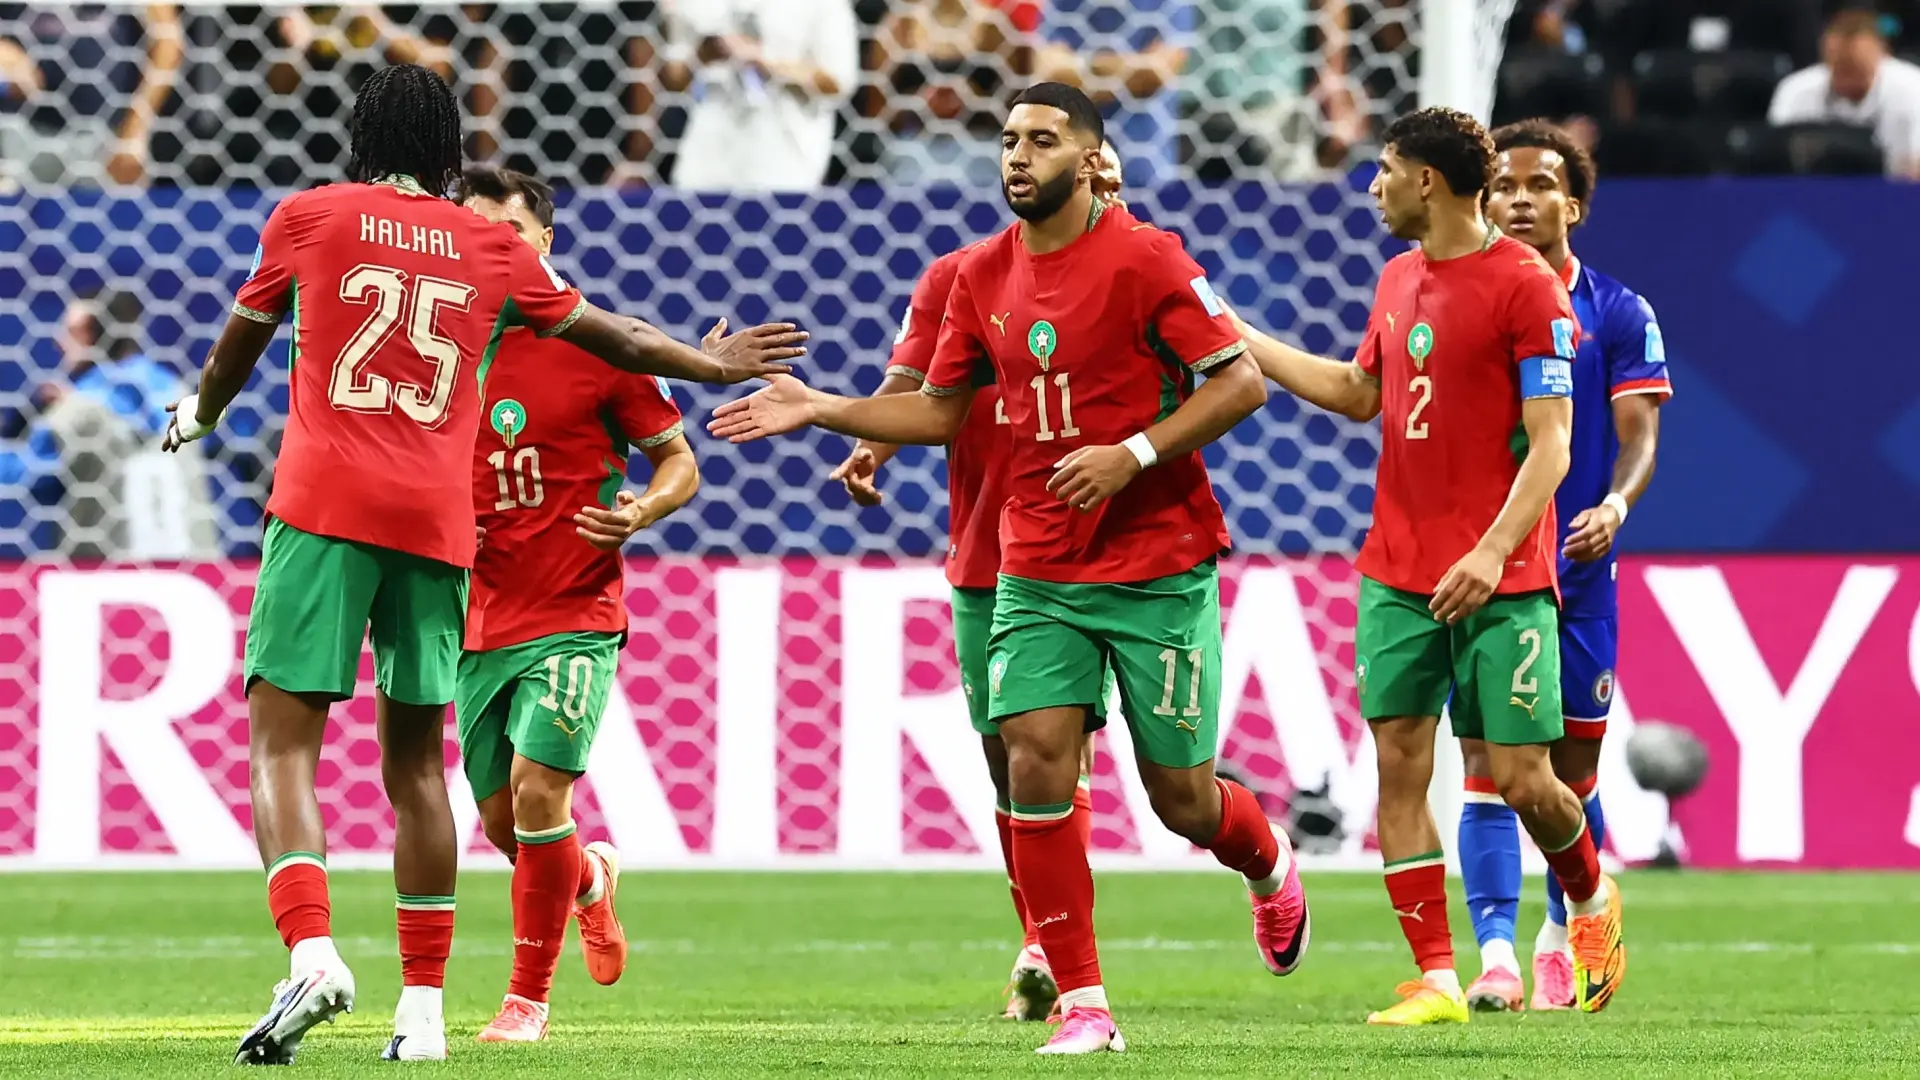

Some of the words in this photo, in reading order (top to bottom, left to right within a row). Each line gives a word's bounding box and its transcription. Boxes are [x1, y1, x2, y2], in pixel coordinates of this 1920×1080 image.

[359, 213, 461, 261] HALHAL
[328, 263, 478, 430] 25
[1029, 372, 1080, 441] 11
[1405, 376, 1432, 439] 2
[487, 446, 544, 511] 10
[537, 653, 593, 720] 10
[1153, 648, 1202, 716] 11
[1511, 628, 1540, 693] 2
